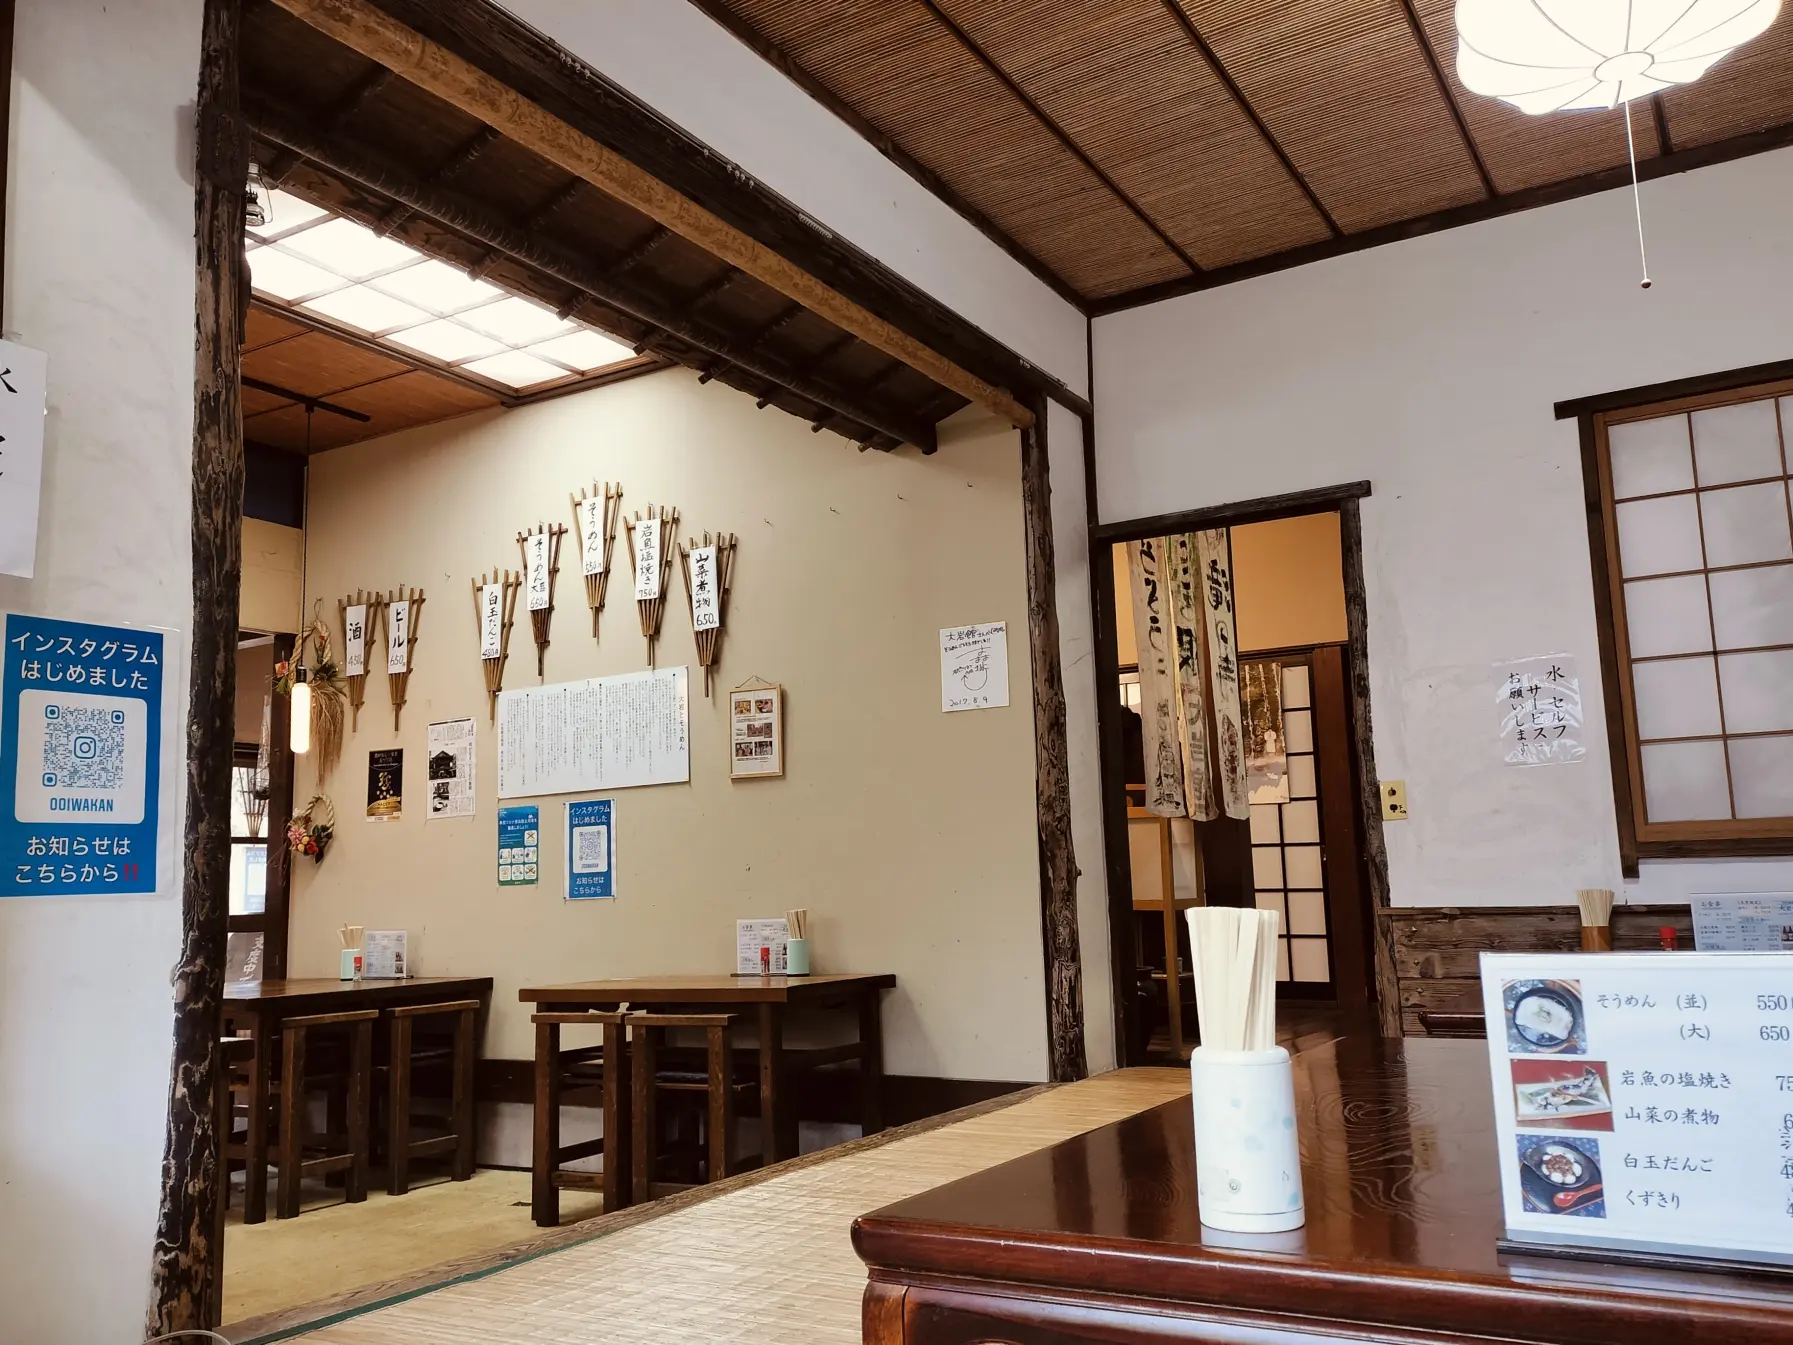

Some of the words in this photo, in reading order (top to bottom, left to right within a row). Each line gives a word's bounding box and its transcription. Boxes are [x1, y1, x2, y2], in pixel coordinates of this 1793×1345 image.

[587, 502, 599, 553] そうめん
[695, 553, 711, 610] 山菜煮物
[348, 622, 362, 642] 酒
[392, 607, 407, 648] ビール
[10, 631, 159, 666] インスタグラム
[21, 659, 148, 690] はじめました
[1508, 672, 1529, 756] お願いします
[570, 804, 611, 816] インスタグラム
[572, 815, 608, 825] はじめました
[27, 836, 130, 856] お知らせは
[1597, 993, 1657, 1009] そうめん
[1757, 994, 1793, 1011] 550
[1680, 1023, 1710, 1042] (大)
[1620, 1069, 1732, 1089] 岩魚の塩焼き
[1625, 1106, 1720, 1126] 山菜の煮物
[1624, 1153, 1714, 1172] 白玉だんご
[1626, 1189, 1681, 1211] くずきり
